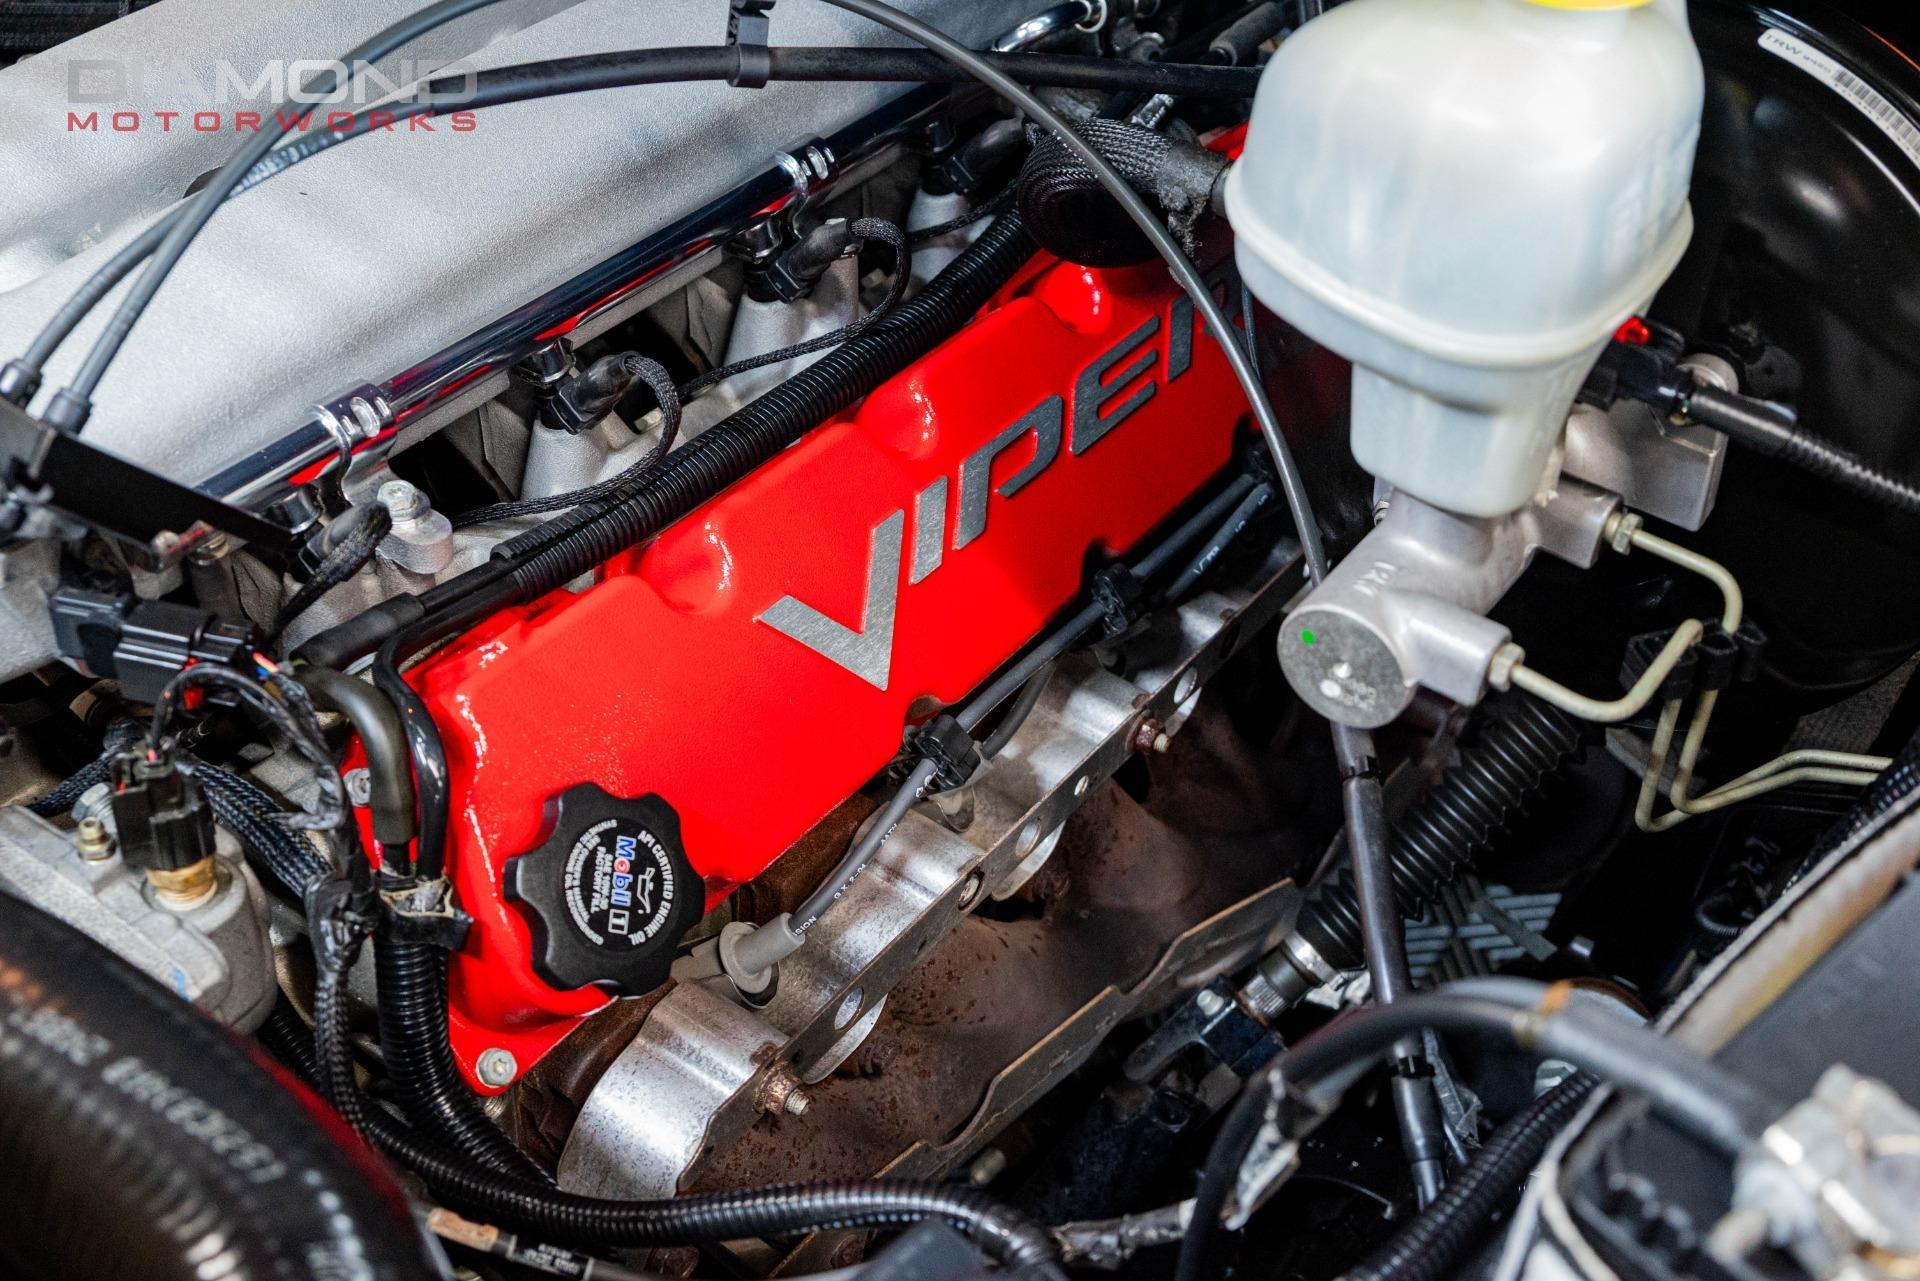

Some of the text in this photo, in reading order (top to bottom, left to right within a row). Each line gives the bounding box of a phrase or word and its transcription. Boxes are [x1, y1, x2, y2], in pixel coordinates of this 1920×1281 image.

[590, 845, 607, 914] FACTORY FILL
[602, 853, 614, 875] SAE
[610, 835, 637, 907] Mobil
[627, 830, 674, 946] API CERTIFIED ENGINE OIL
[792, 915, 817, 937] SION
